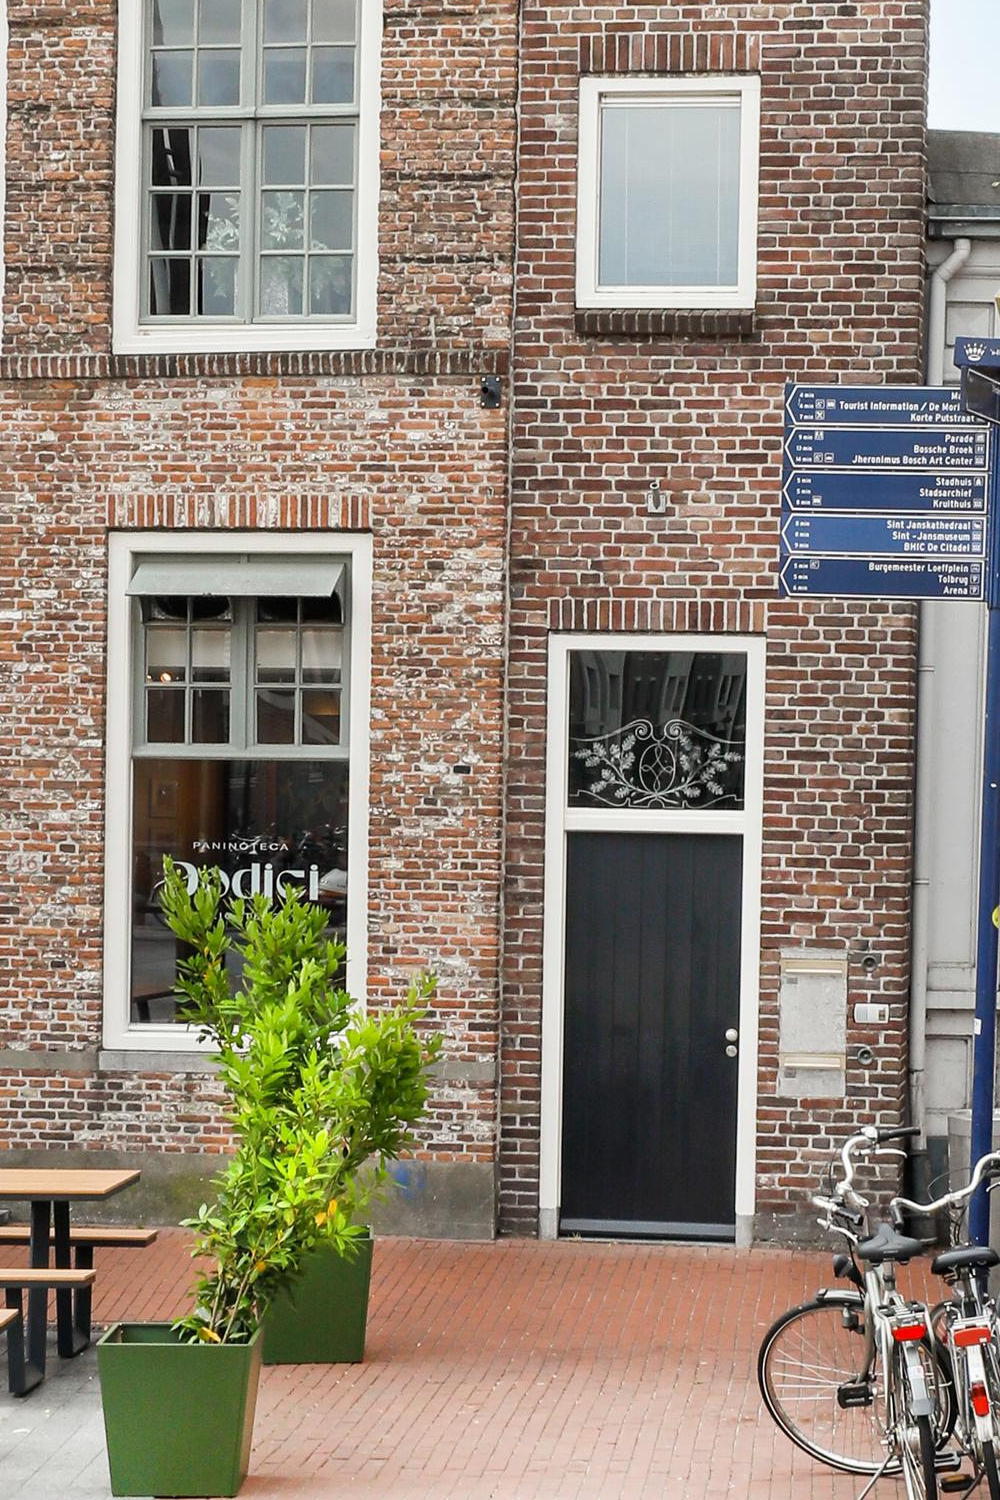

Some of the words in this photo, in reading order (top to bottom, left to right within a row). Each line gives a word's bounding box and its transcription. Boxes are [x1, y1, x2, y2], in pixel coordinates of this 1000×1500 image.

[840, 401, 868, 410] Tourist
[870, 401, 919, 411] Information
[929, 402, 940, 411] De
[942, 402, 960, 411] Mori
[910, 413, 933, 422] Korte
[935, 414, 975, 423] Putstraat
[945, 434, 974, 443] Parade
[913, 444, 947, 454] Bossche
[949, 445, 973, 454] Broek
[852, 454, 900, 464] Jheronimus
[902, 455, 927, 464] Bosch
[929, 456, 943, 465] Art
[945, 456, 973, 465] Center
[936, 477, 972, 486] Stadhuis
[919, 488, 972, 497] Stadsarchief
[932, 499, 971, 508] Kruithuis
[886, 520, 904, 529] Sint
[906, 520, 971, 530] Janskathedraal
[892, 531, 910, 540] Sint
[903, 542, 926, 551] BHIC
[927, 543, 938, 551] De
[940, 543, 970, 552] Citadel
[868, 562, 925, 573] Burgemeester
[927, 563, 969, 573] Loeffplein
[938, 574, 969, 586] Tolbrug
[943, 586, 968, 595] Arena
[192, 841, 290, 851] PANINOTECA
